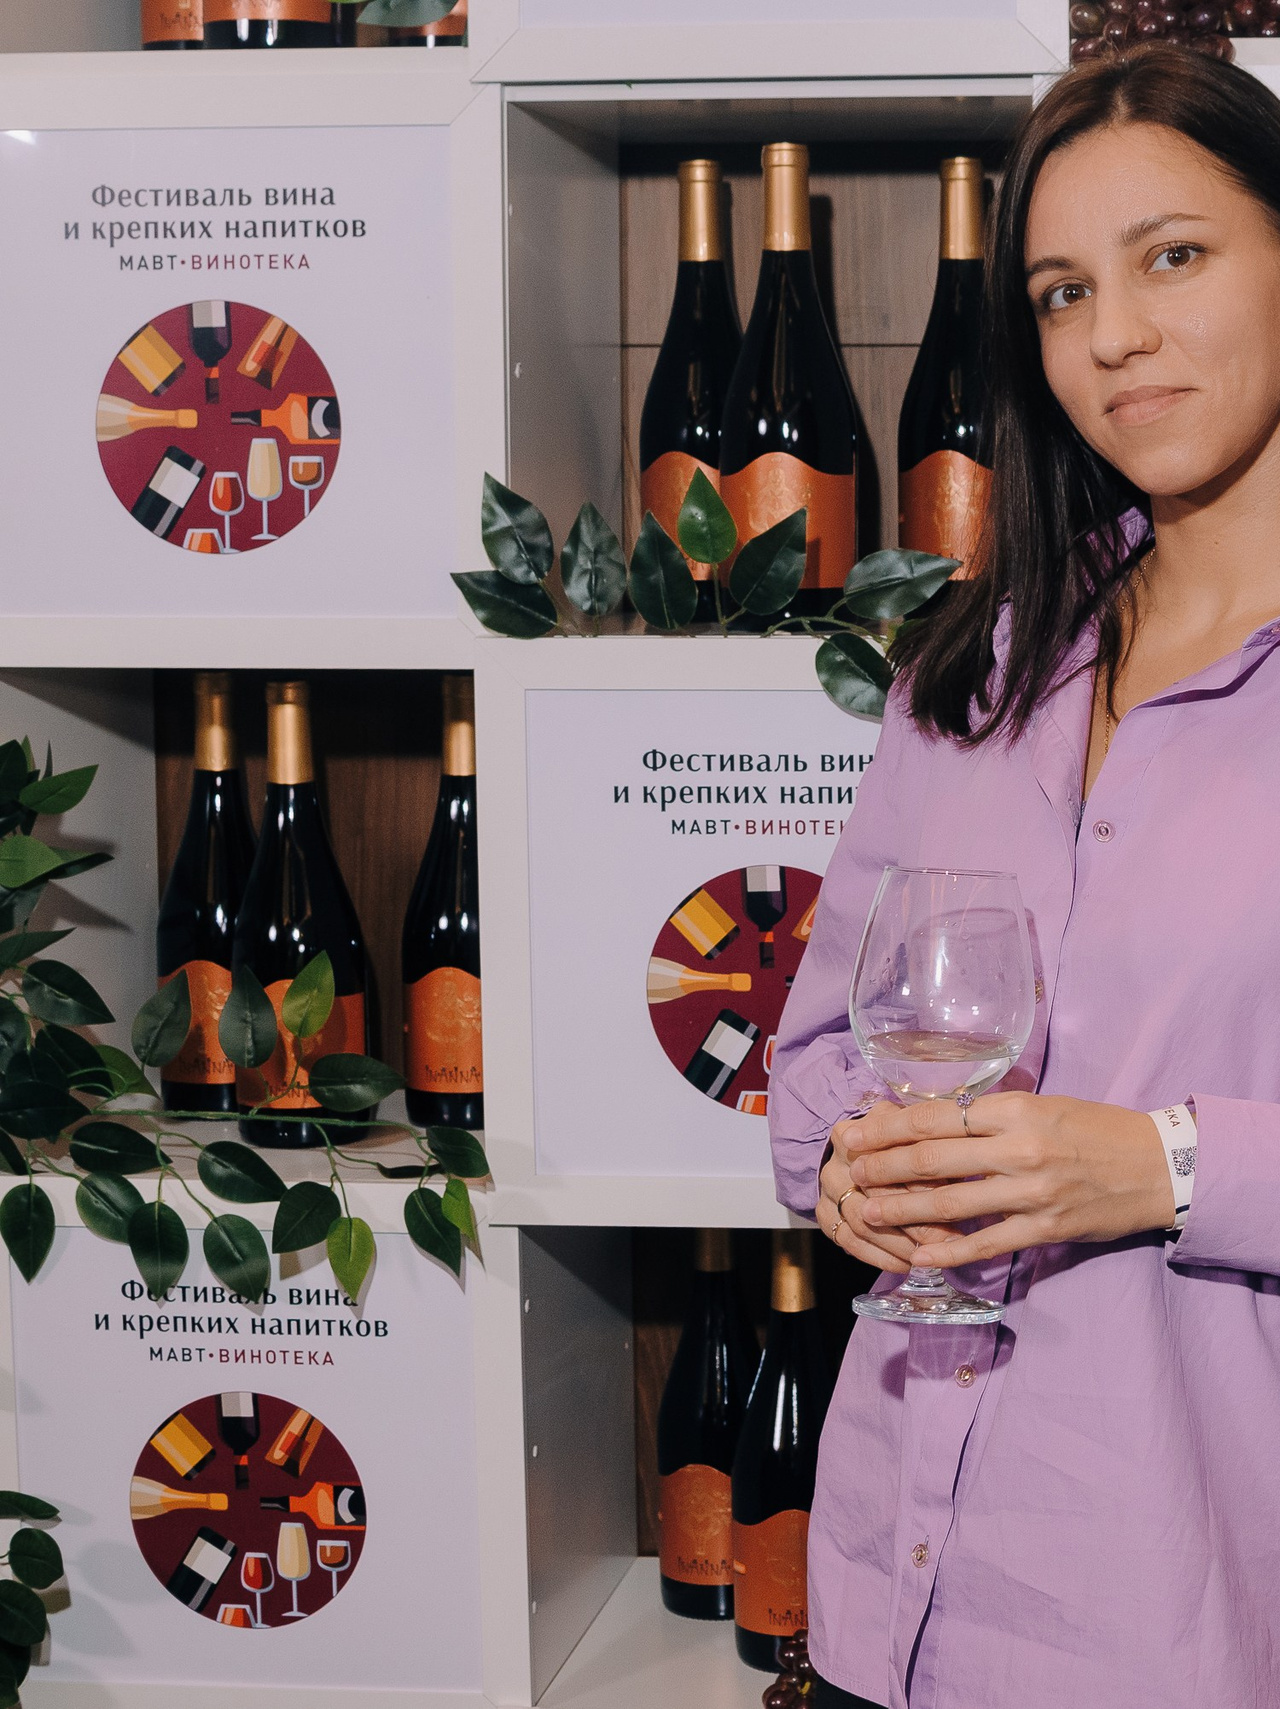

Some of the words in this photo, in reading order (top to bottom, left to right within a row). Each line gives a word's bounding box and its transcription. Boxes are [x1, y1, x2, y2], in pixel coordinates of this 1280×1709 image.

[91, 184, 253, 207] Фестиваль
[264, 186, 336, 206] вина
[63, 220, 80, 240] и
[92, 219, 213, 248] крепких
[225, 218, 367, 239] напитков
[642, 749, 808, 772] Фестиваль
[820, 754, 874, 772] вин
[613, 785, 630, 804] и
[642, 785, 768, 812] крепких
[94, 1312, 110, 1330] и
[122, 1313, 239, 1339] крепких
[251, 1316, 389, 1337] напитков
